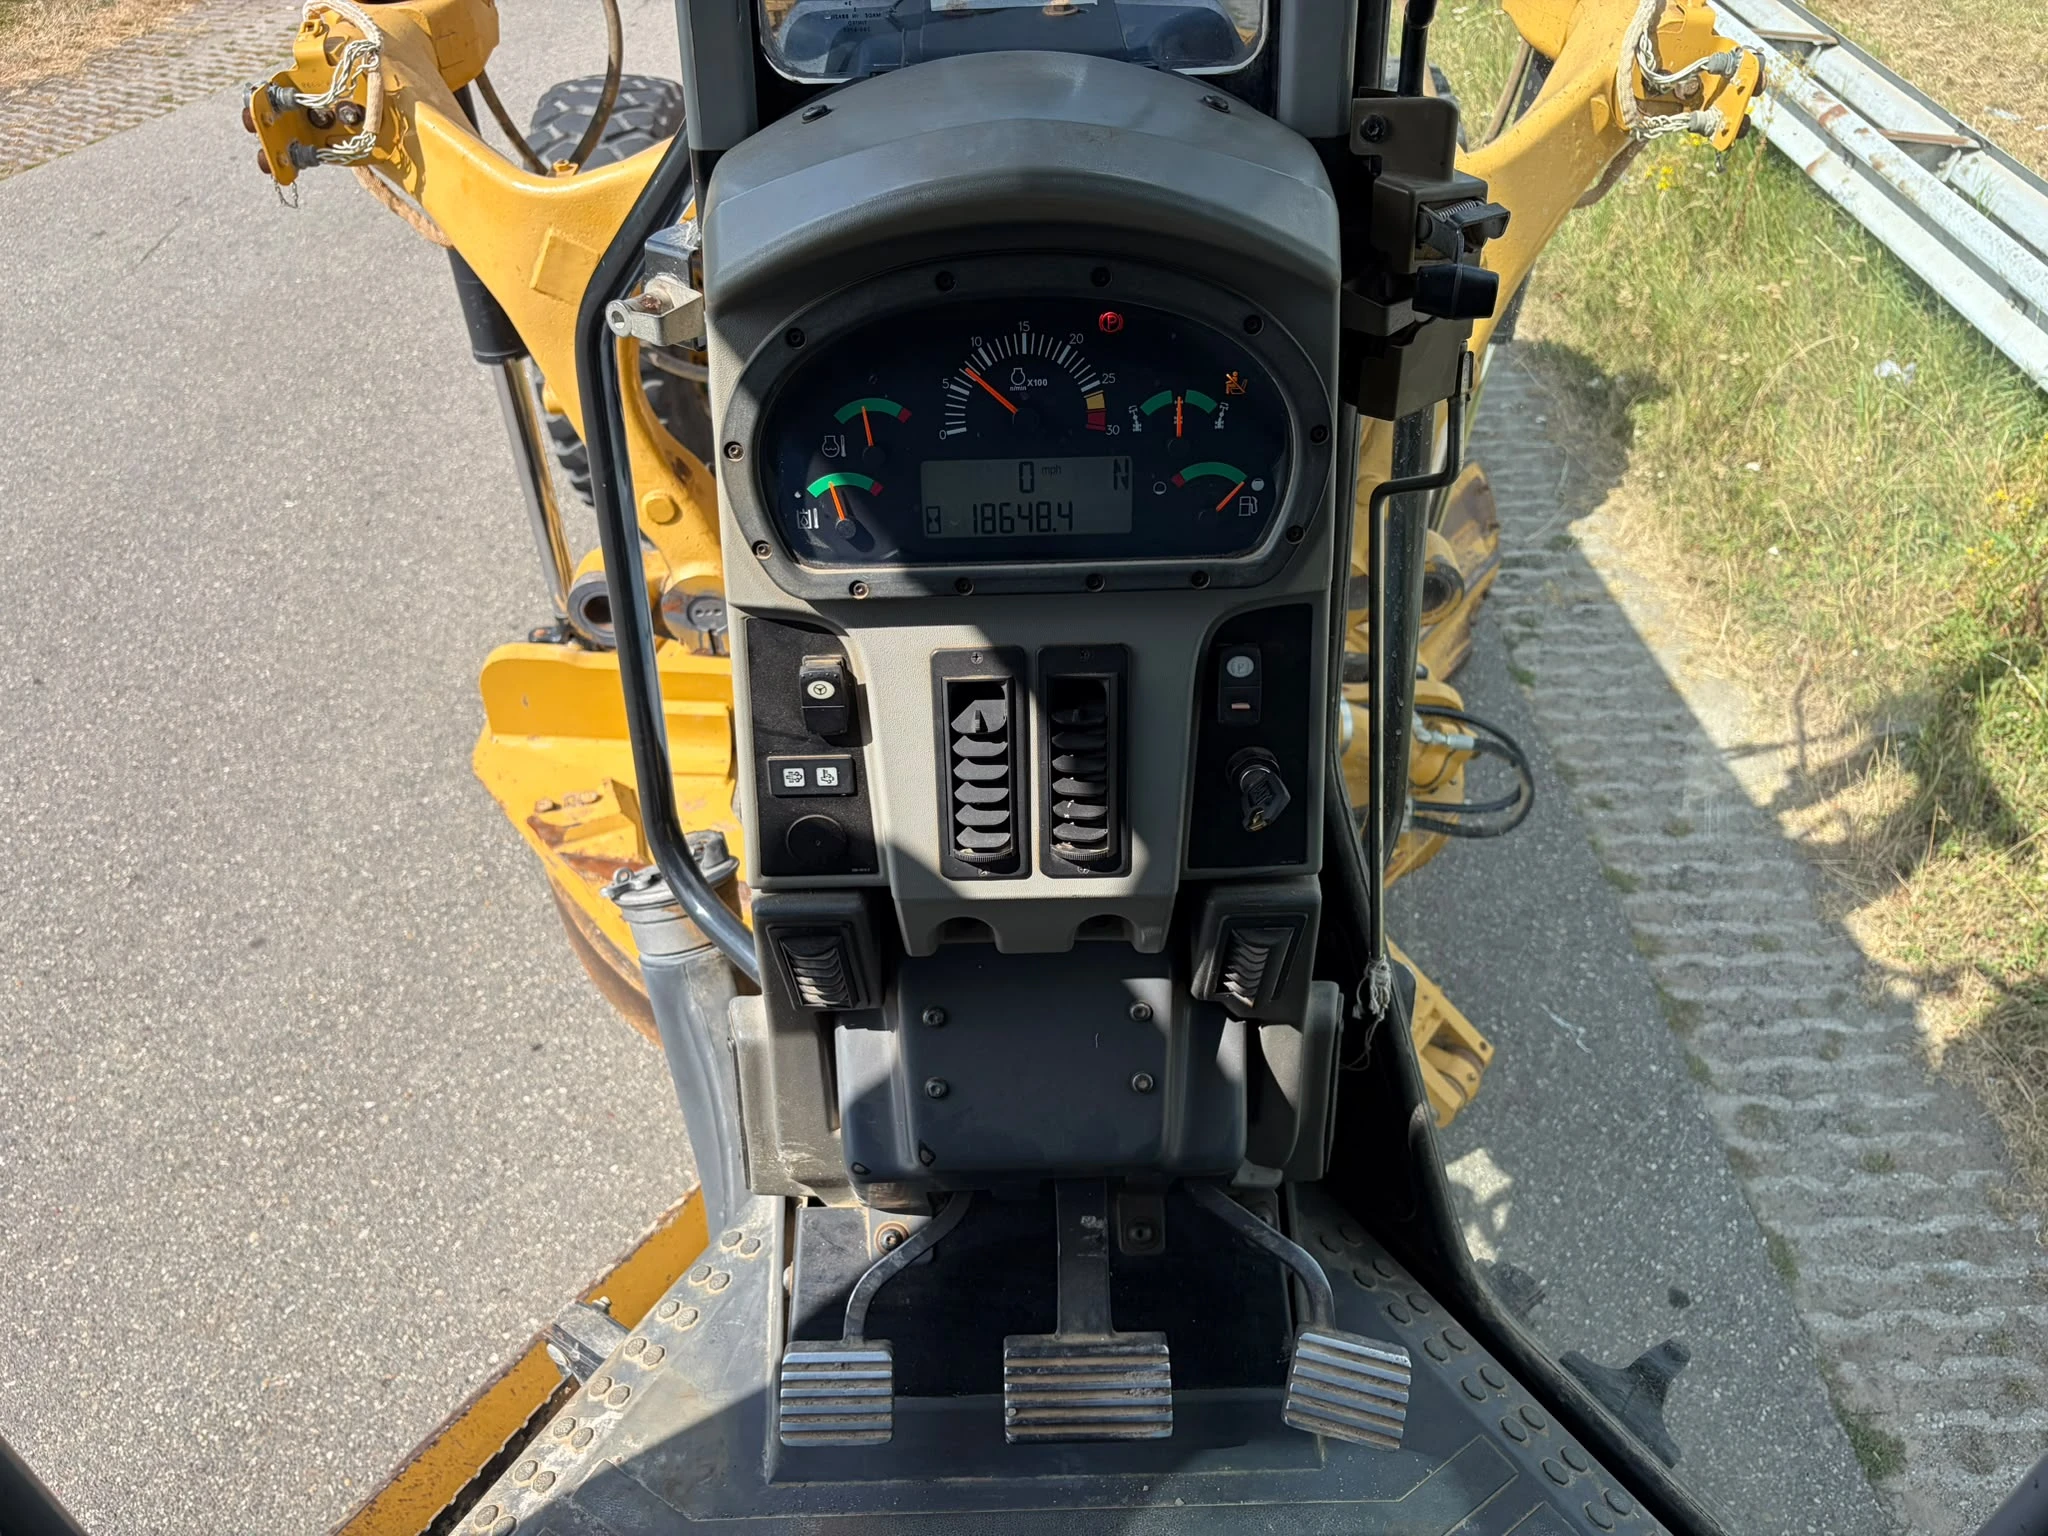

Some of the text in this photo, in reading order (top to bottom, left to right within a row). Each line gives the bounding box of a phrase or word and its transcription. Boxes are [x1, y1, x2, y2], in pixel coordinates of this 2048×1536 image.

[1018, 321, 1030, 332] 15
[970, 336, 983, 347] 10
[1069, 333, 1084, 345] 20
[942, 378, 950, 389] 5
[1026, 378, 1048, 387] X100
[1101, 372, 1116, 384] 25
[939, 429, 947, 440] 0
[1105, 424, 1120, 436] 30
[1018, 461, 1062, 494] 0 mph
[1113, 458, 1129, 491] N
[972, 501, 1073, 535] 18648.4
